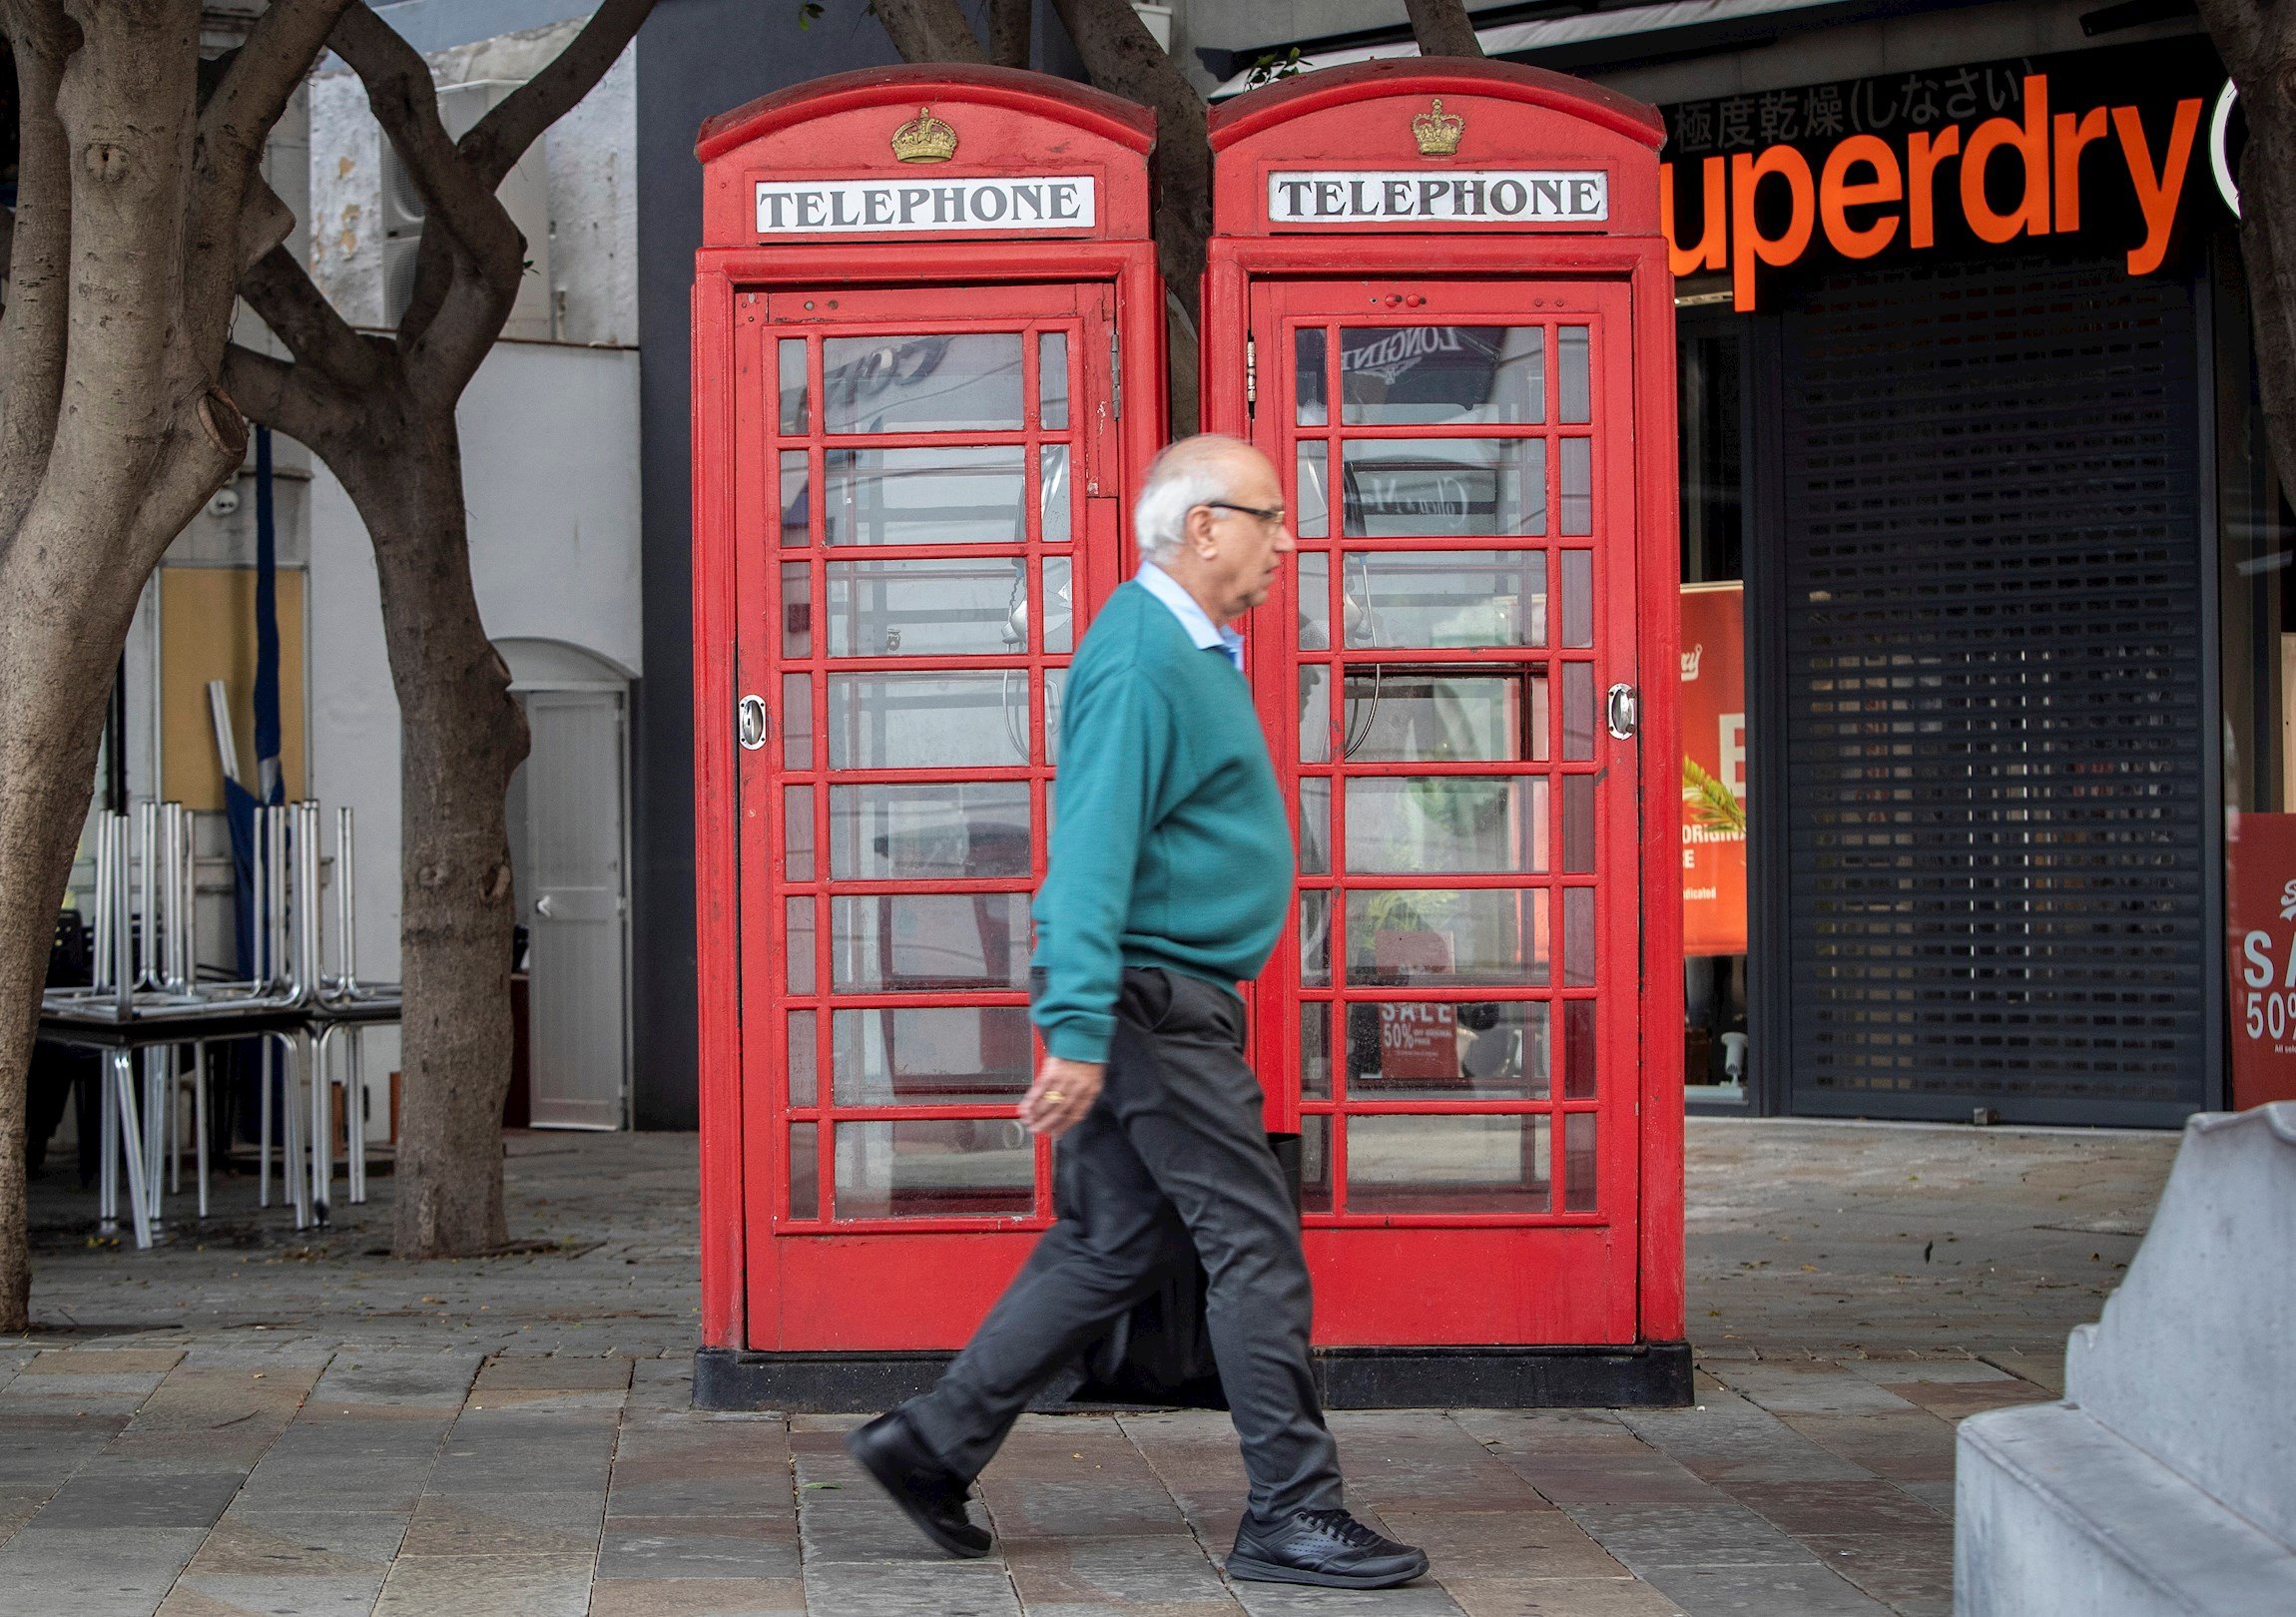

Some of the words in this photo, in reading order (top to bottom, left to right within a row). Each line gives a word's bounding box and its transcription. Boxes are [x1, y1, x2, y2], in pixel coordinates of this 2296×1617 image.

[760, 184, 1081, 229] TELEPHONE
[1278, 179, 1601, 216] TELEPHONE
[1382, 1002, 1451, 1023] SALE
[1384, 1022, 1415, 1048] 50%
